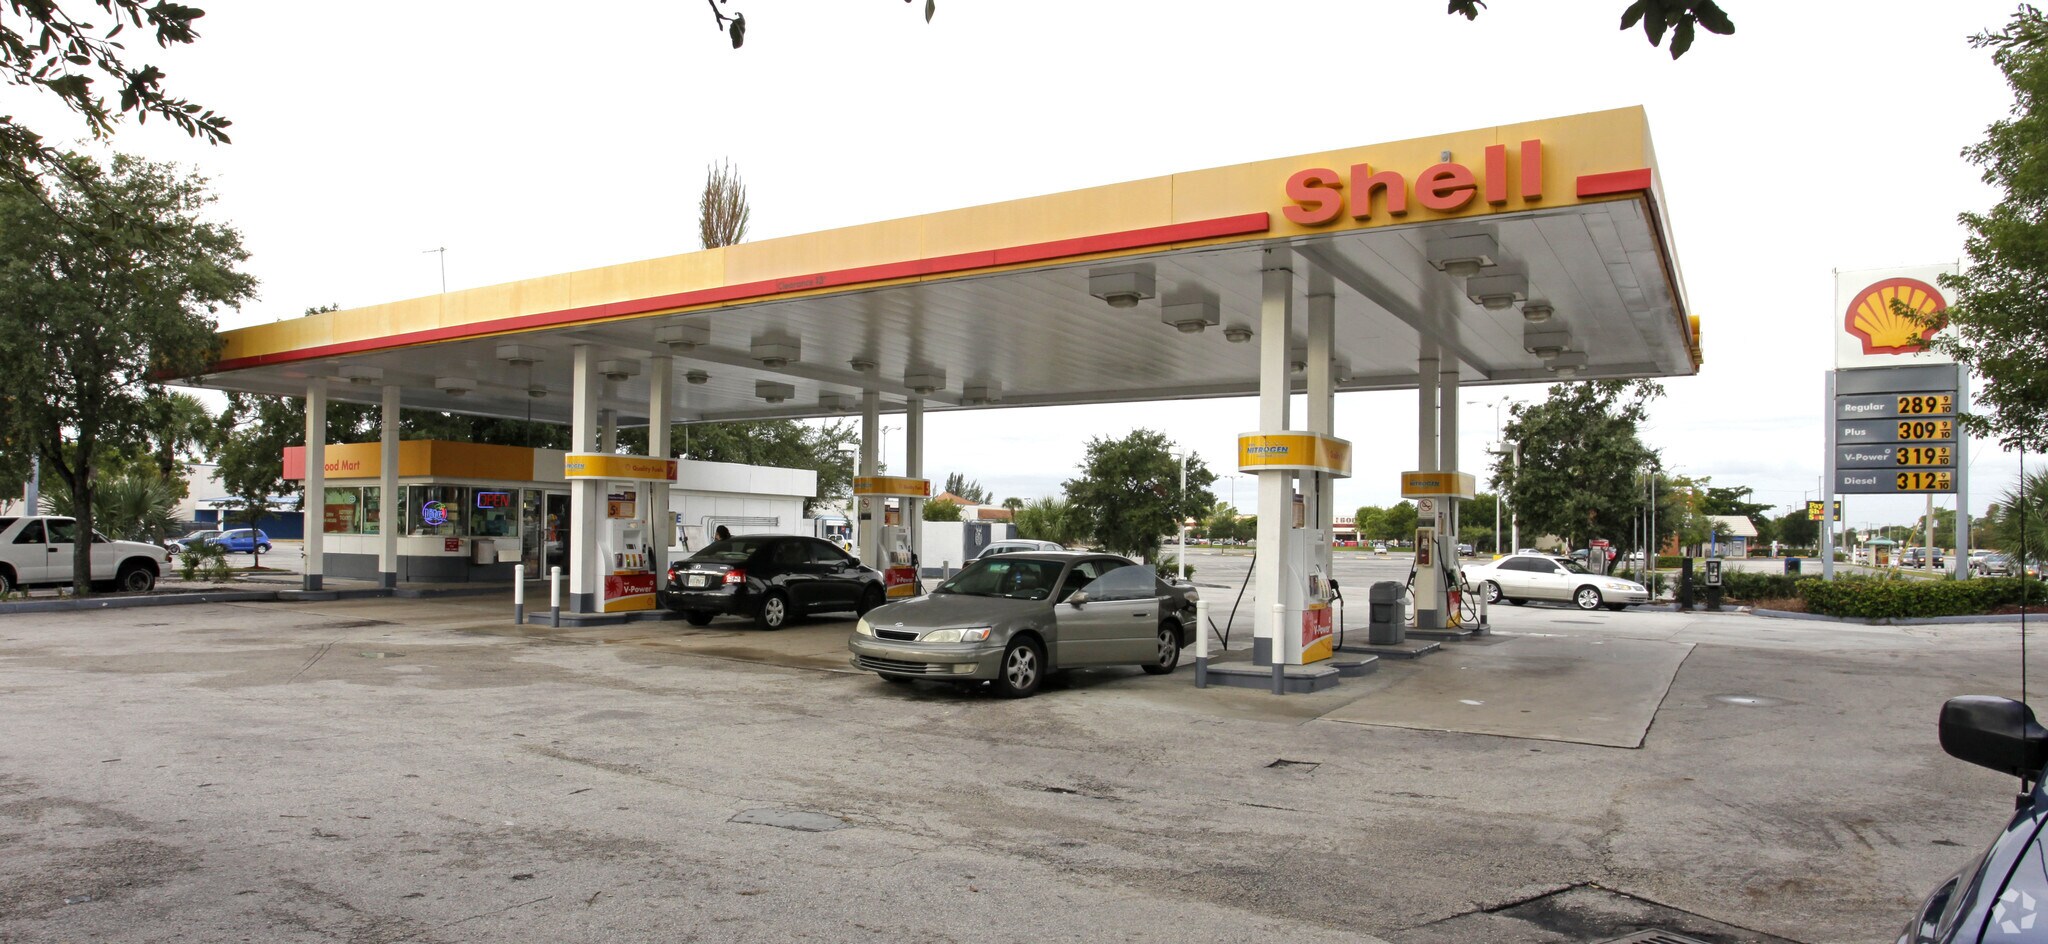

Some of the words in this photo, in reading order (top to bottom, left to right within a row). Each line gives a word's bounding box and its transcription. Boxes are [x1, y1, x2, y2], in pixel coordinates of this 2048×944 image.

[1282, 138, 1542, 227] Shell
[1844, 403, 1885, 413] Regular
[1898, 396, 1937, 414] 289
[1844, 428, 1867, 436] Plus
[1899, 422, 1936, 439] 309
[1247, 446, 1288, 454] NITROGEN
[1844, 453, 1889, 461] V-Power
[1896, 447, 1936, 465] 319
[324, 459, 340, 472] ood
[341, 459, 361, 471] Mart
[632, 465, 651, 473] Quality
[1844, 476, 1877, 485] Diesel
[1896, 472, 1936, 490] 312
[480, 495, 508, 507] OPEN
[623, 585, 652, 593] V-Power
[1313, 625, 1330, 635] V-Power
